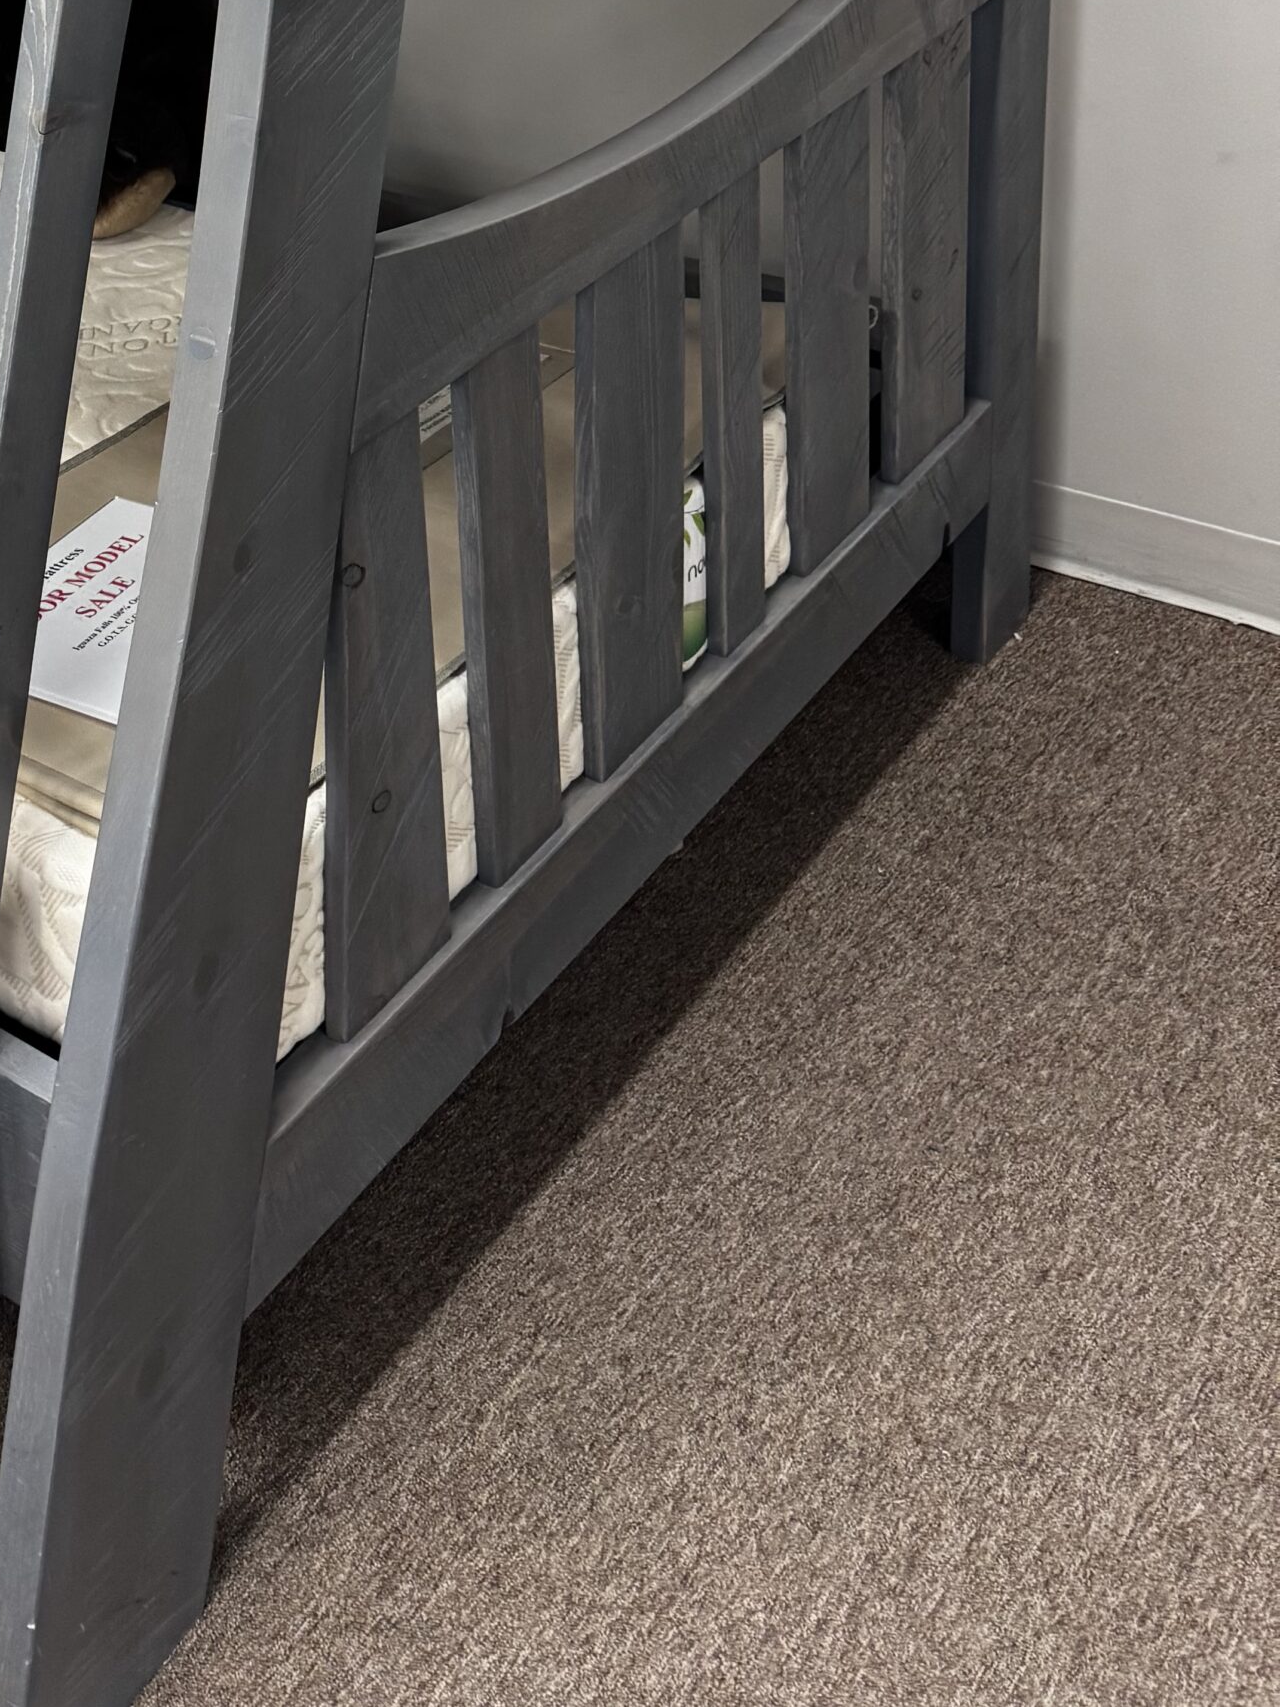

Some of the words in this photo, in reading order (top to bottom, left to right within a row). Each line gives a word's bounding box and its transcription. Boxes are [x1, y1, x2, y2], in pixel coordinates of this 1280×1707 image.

[37, 588, 74, 620] OR
[63, 533, 145, 588] MODEL
[75, 576, 135, 619] SALE
[94, 619, 113, 634] Falls
